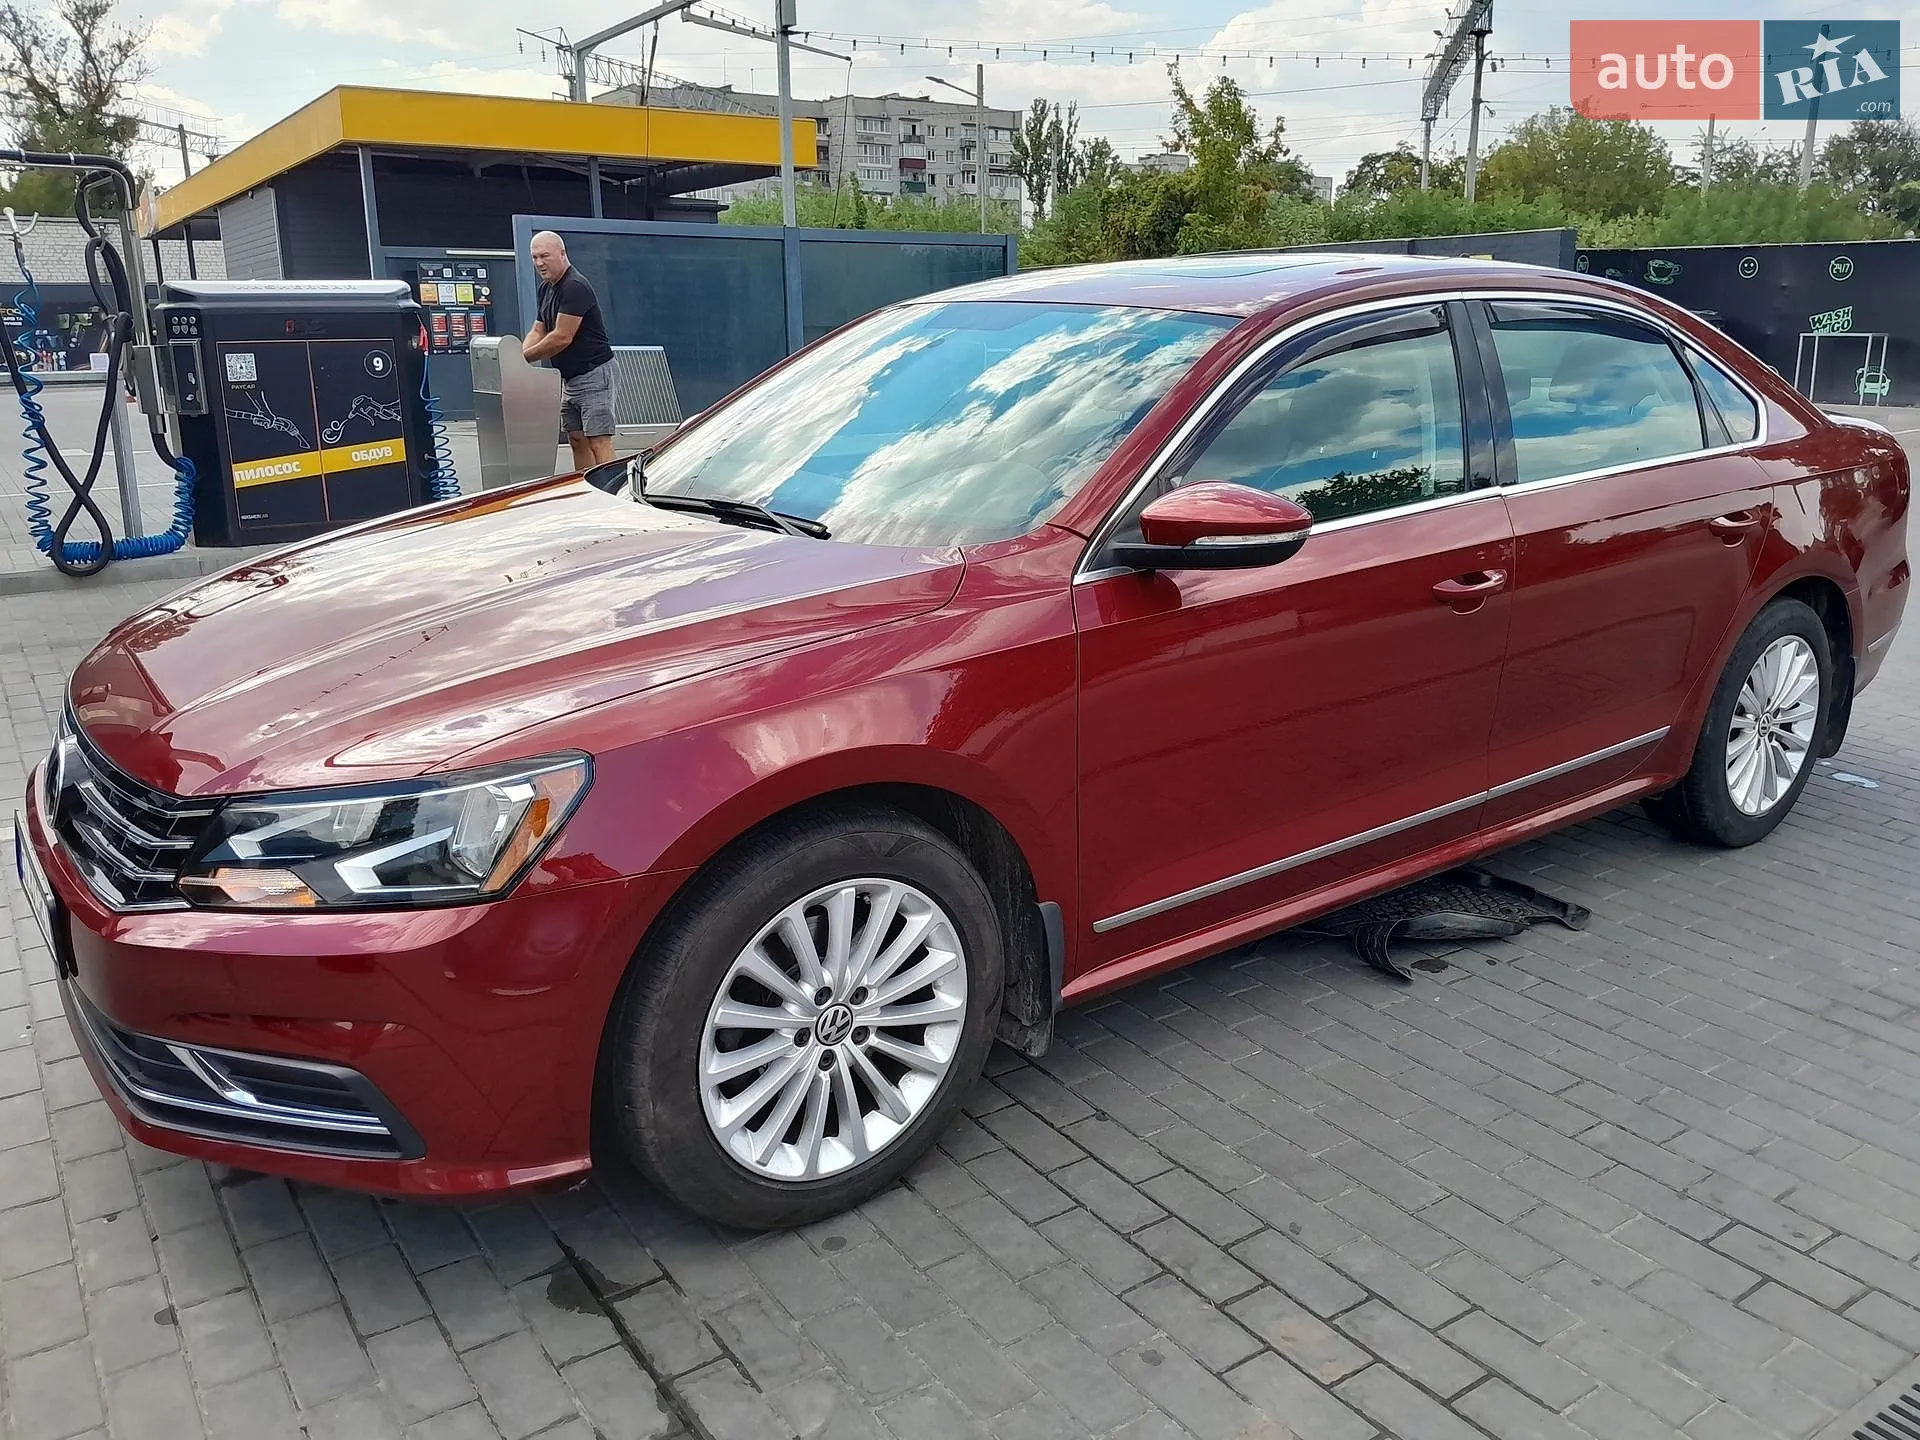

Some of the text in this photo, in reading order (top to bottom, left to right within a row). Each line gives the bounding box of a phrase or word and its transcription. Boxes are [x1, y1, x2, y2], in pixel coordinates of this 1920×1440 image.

[1811, 308, 1851, 328] WASH
[1830, 319, 1851, 334] GO
[373, 357, 383, 371] 9
[352, 447, 393, 463] ОБДУВ
[234, 461, 302, 482] ПИЛОСОС
